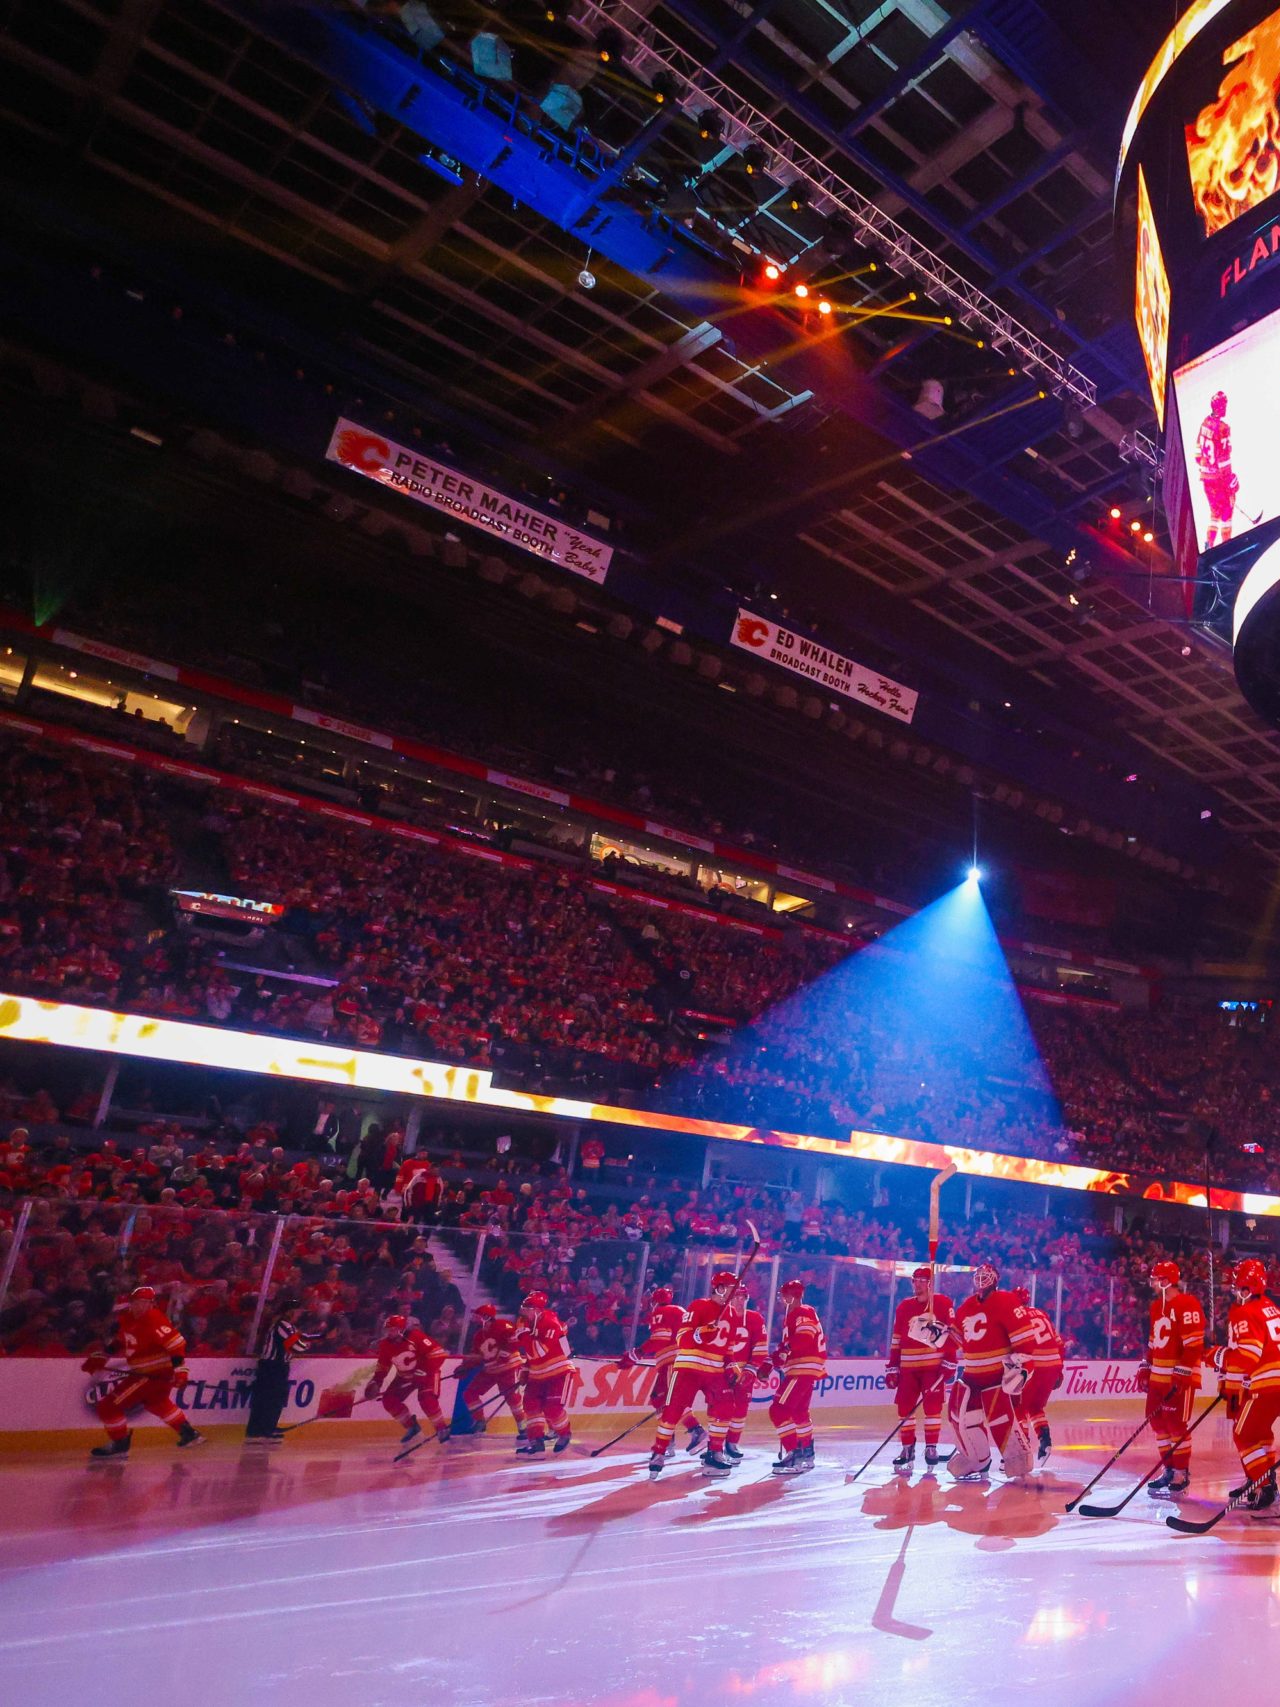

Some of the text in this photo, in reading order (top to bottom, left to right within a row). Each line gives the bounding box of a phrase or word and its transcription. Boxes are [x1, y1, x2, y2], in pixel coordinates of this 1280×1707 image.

[394, 453, 475, 501] PETER
[480, 491, 558, 541] MAHER
[390, 472, 554, 556] RADIO BROADCAST BOOTH
[776, 629, 794, 649] ED
[800, 640, 853, 677] WHALEN
[770, 648, 850, 692] BROADCAST BOOTH
[856, 682, 888, 705] Hockey
[652, 1314, 662, 1324] 17
[682, 1312, 693, 1323] 21
[1170, 1308, 1176, 1322] A
[1183, 1312, 1200, 1324] 28
[545, 1329, 555, 1339] 11
[812, 1373, 885, 1397] upreme
[1066, 1365, 1097, 1394] Tim
[176, 1379, 315, 1410] CLAMTO
